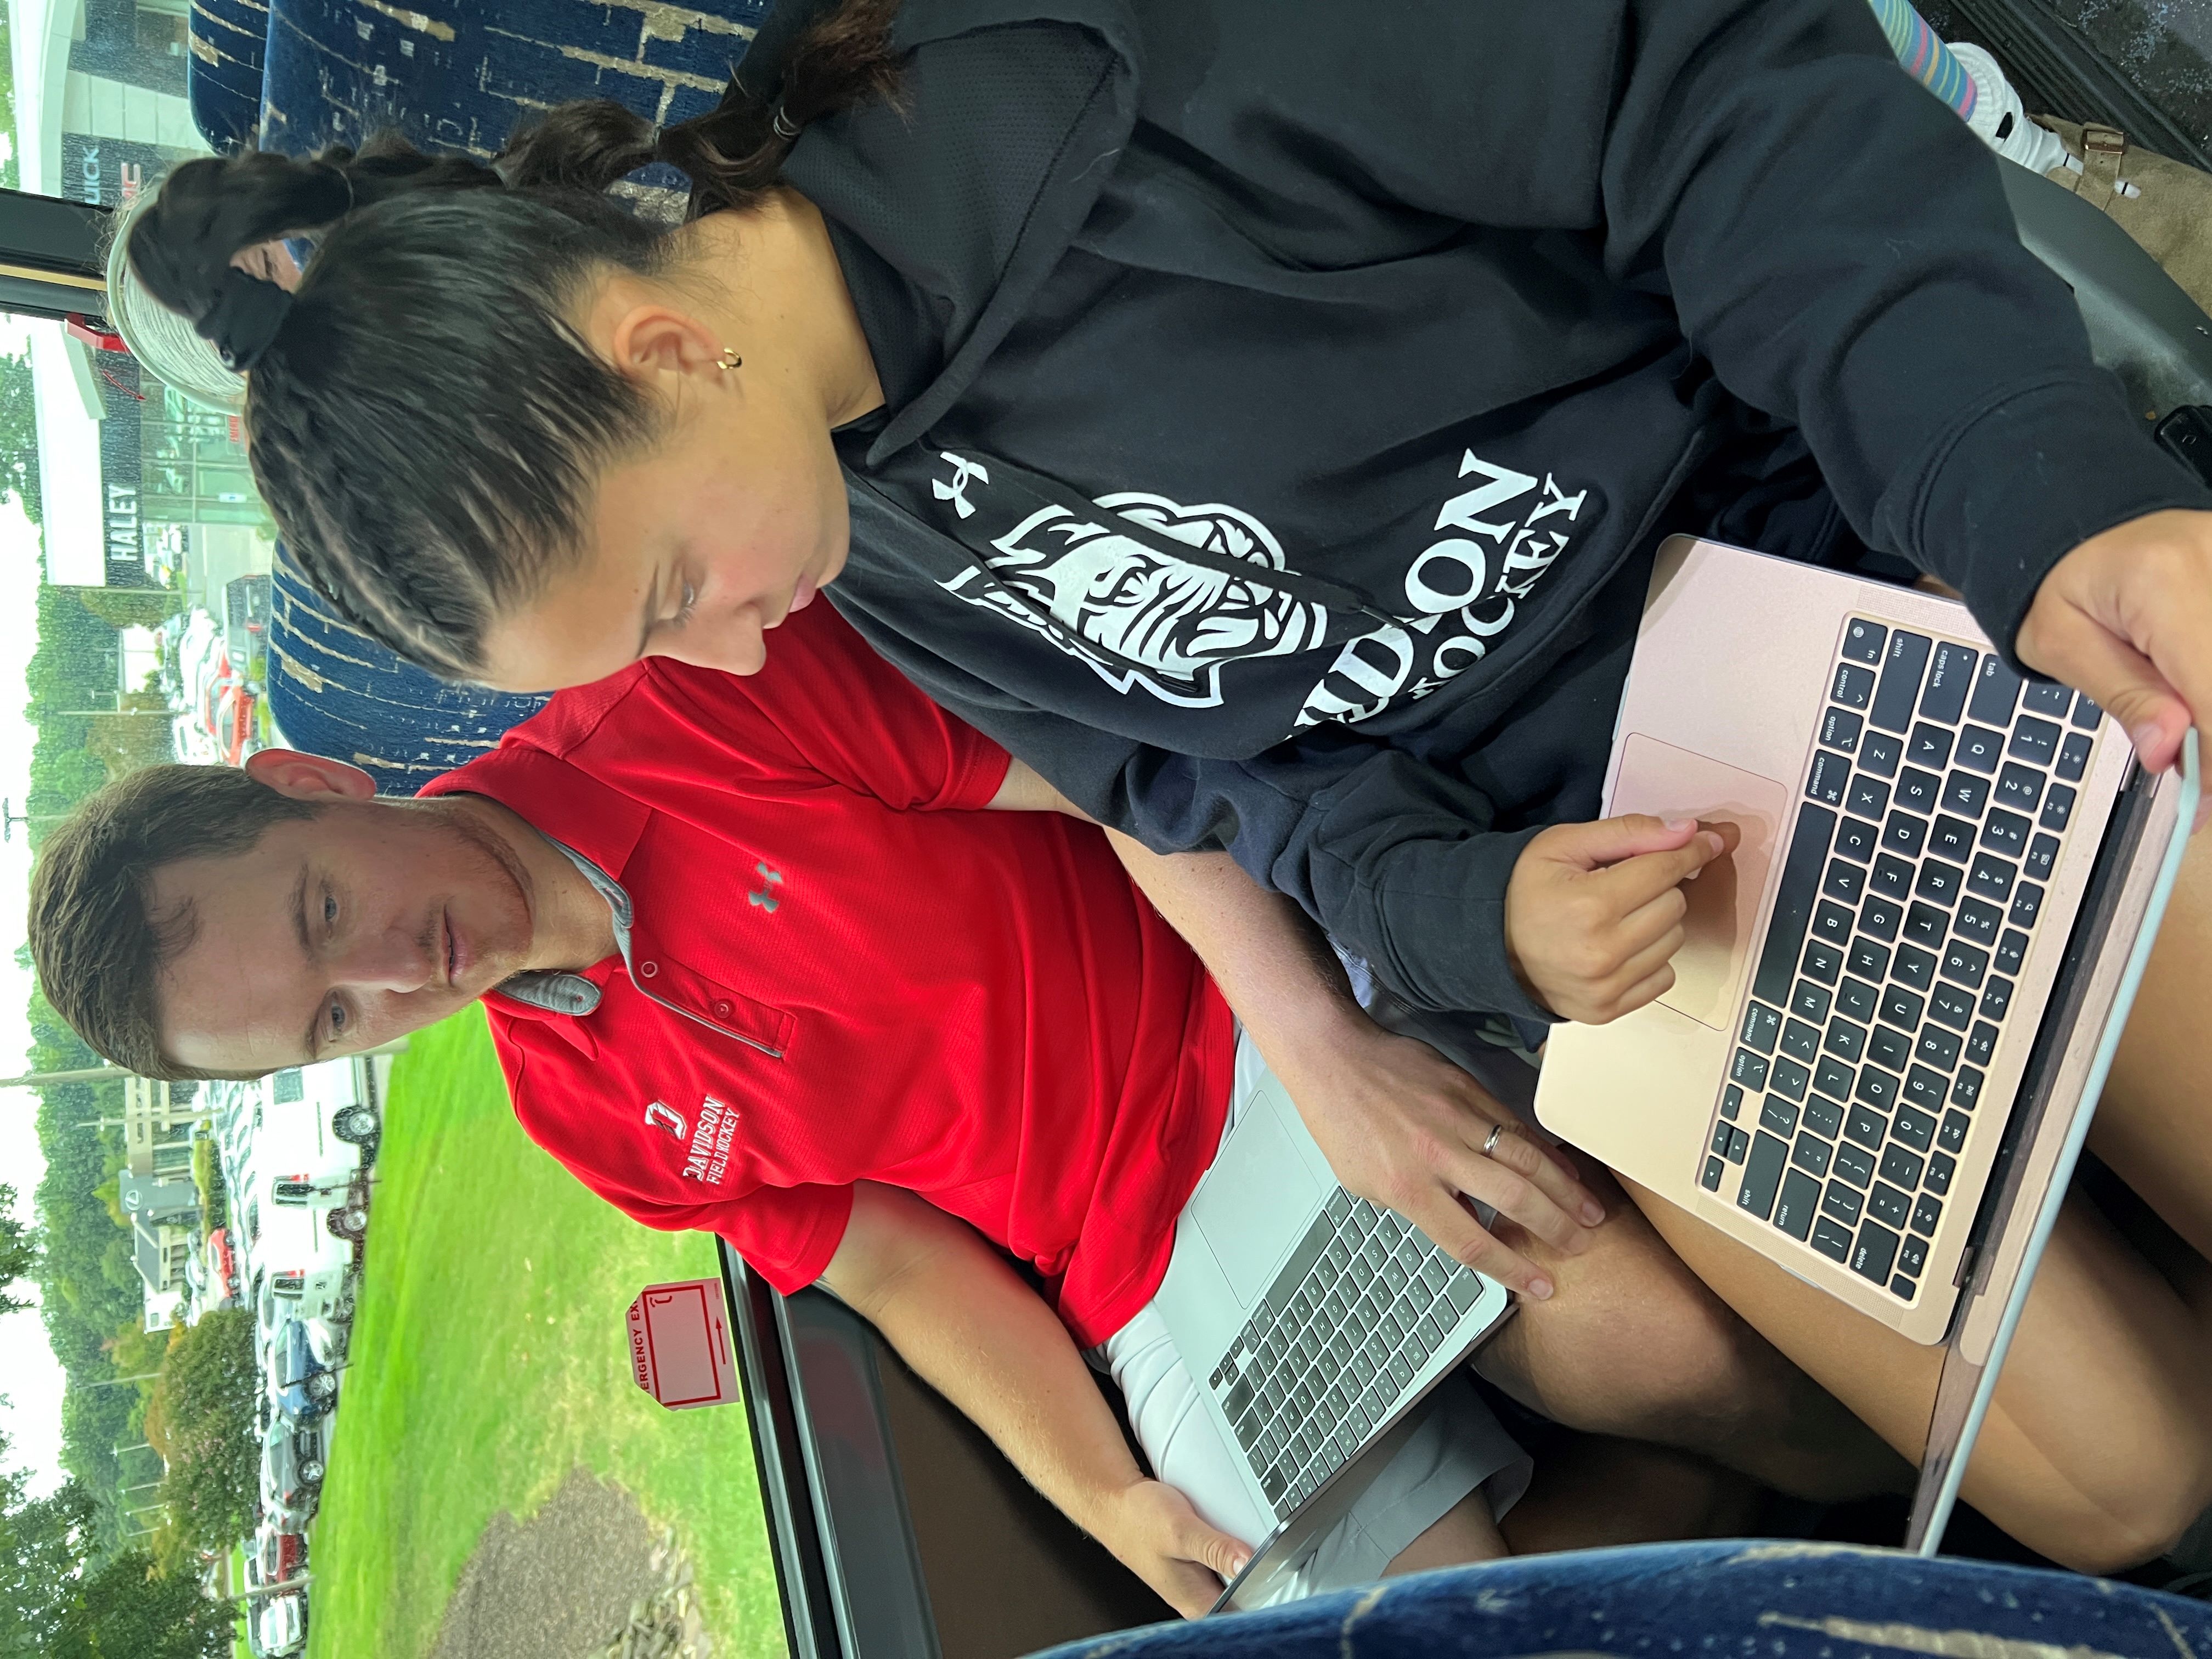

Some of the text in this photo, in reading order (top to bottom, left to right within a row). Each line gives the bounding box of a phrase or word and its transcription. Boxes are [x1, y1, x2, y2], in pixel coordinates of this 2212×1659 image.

[83, 147, 100, 205] UICK
[109, 484, 137, 561] HALEY
[1892, 638, 1904, 657] shift
[1867, 650, 1876, 659] fn
[1932, 649, 1949, 687] caps lock
[1985, 662, 1997, 677] tab
[1836, 669, 1849, 698] control
[1824, 716, 1837, 741] option
[1923, 741, 1934, 750] A
[1971, 744, 1984, 754] Q
[1874, 749, 1886, 759] Z
[1810, 757, 1826, 795] command
[2005, 780, 2018, 791] 2
[2023, 786, 2033, 795] @
[1910, 786, 1922, 796] S
[1958, 789, 1972, 802] W
[1861, 793, 1873, 803] X
[1898, 829, 1910, 839] D
[1991, 826, 2004, 836] 3
[1849, 836, 1861, 845] C
[1945, 834, 1957, 844] E
[1887, 872, 1897, 882] F
[1978, 870, 1989, 880] 4
[1838, 879, 1849, 888] V
[1932, 877, 1945, 888] R
[1827, 918, 1838, 928] B
[1874, 914, 1885, 924] G
[1965, 915, 1977, 924] 5
[1920, 923, 1932, 931] T
[1815, 958, 1827, 969] N
[1861, 955, 1874, 966] H
[1951, 957, 1963, 967] 6
[1908, 964, 1919, 973] Y
[1804, 997, 1816, 1008] M
[1850, 996, 1860, 1005] J
[1939, 1000, 1950, 1009] 7
[1894, 1003, 1906, 1014] U
[1744, 1008, 1759, 1042] command
[1838, 1035, 1850, 1045] K
[1925, 1040, 1937, 1050] 8
[1735, 1054, 1747, 1077] option
[1871, 1084, 1882, 1093] O
[1913, 1081, 1924, 1091] 9
[1860, 1122, 1871, 1132] P
[1900, 1121, 1912, 1130] 0
[682, 1094, 725, 1182] DAVIDSON
[706, 1107, 740, 1184] FIELD HOCKEY
[1741, 1189, 1751, 1206] shift
[1778, 1205, 1789, 1226] return
[1855, 1247, 1869, 1270] delete
[633, 1329, 650, 1393] ERGENCY
